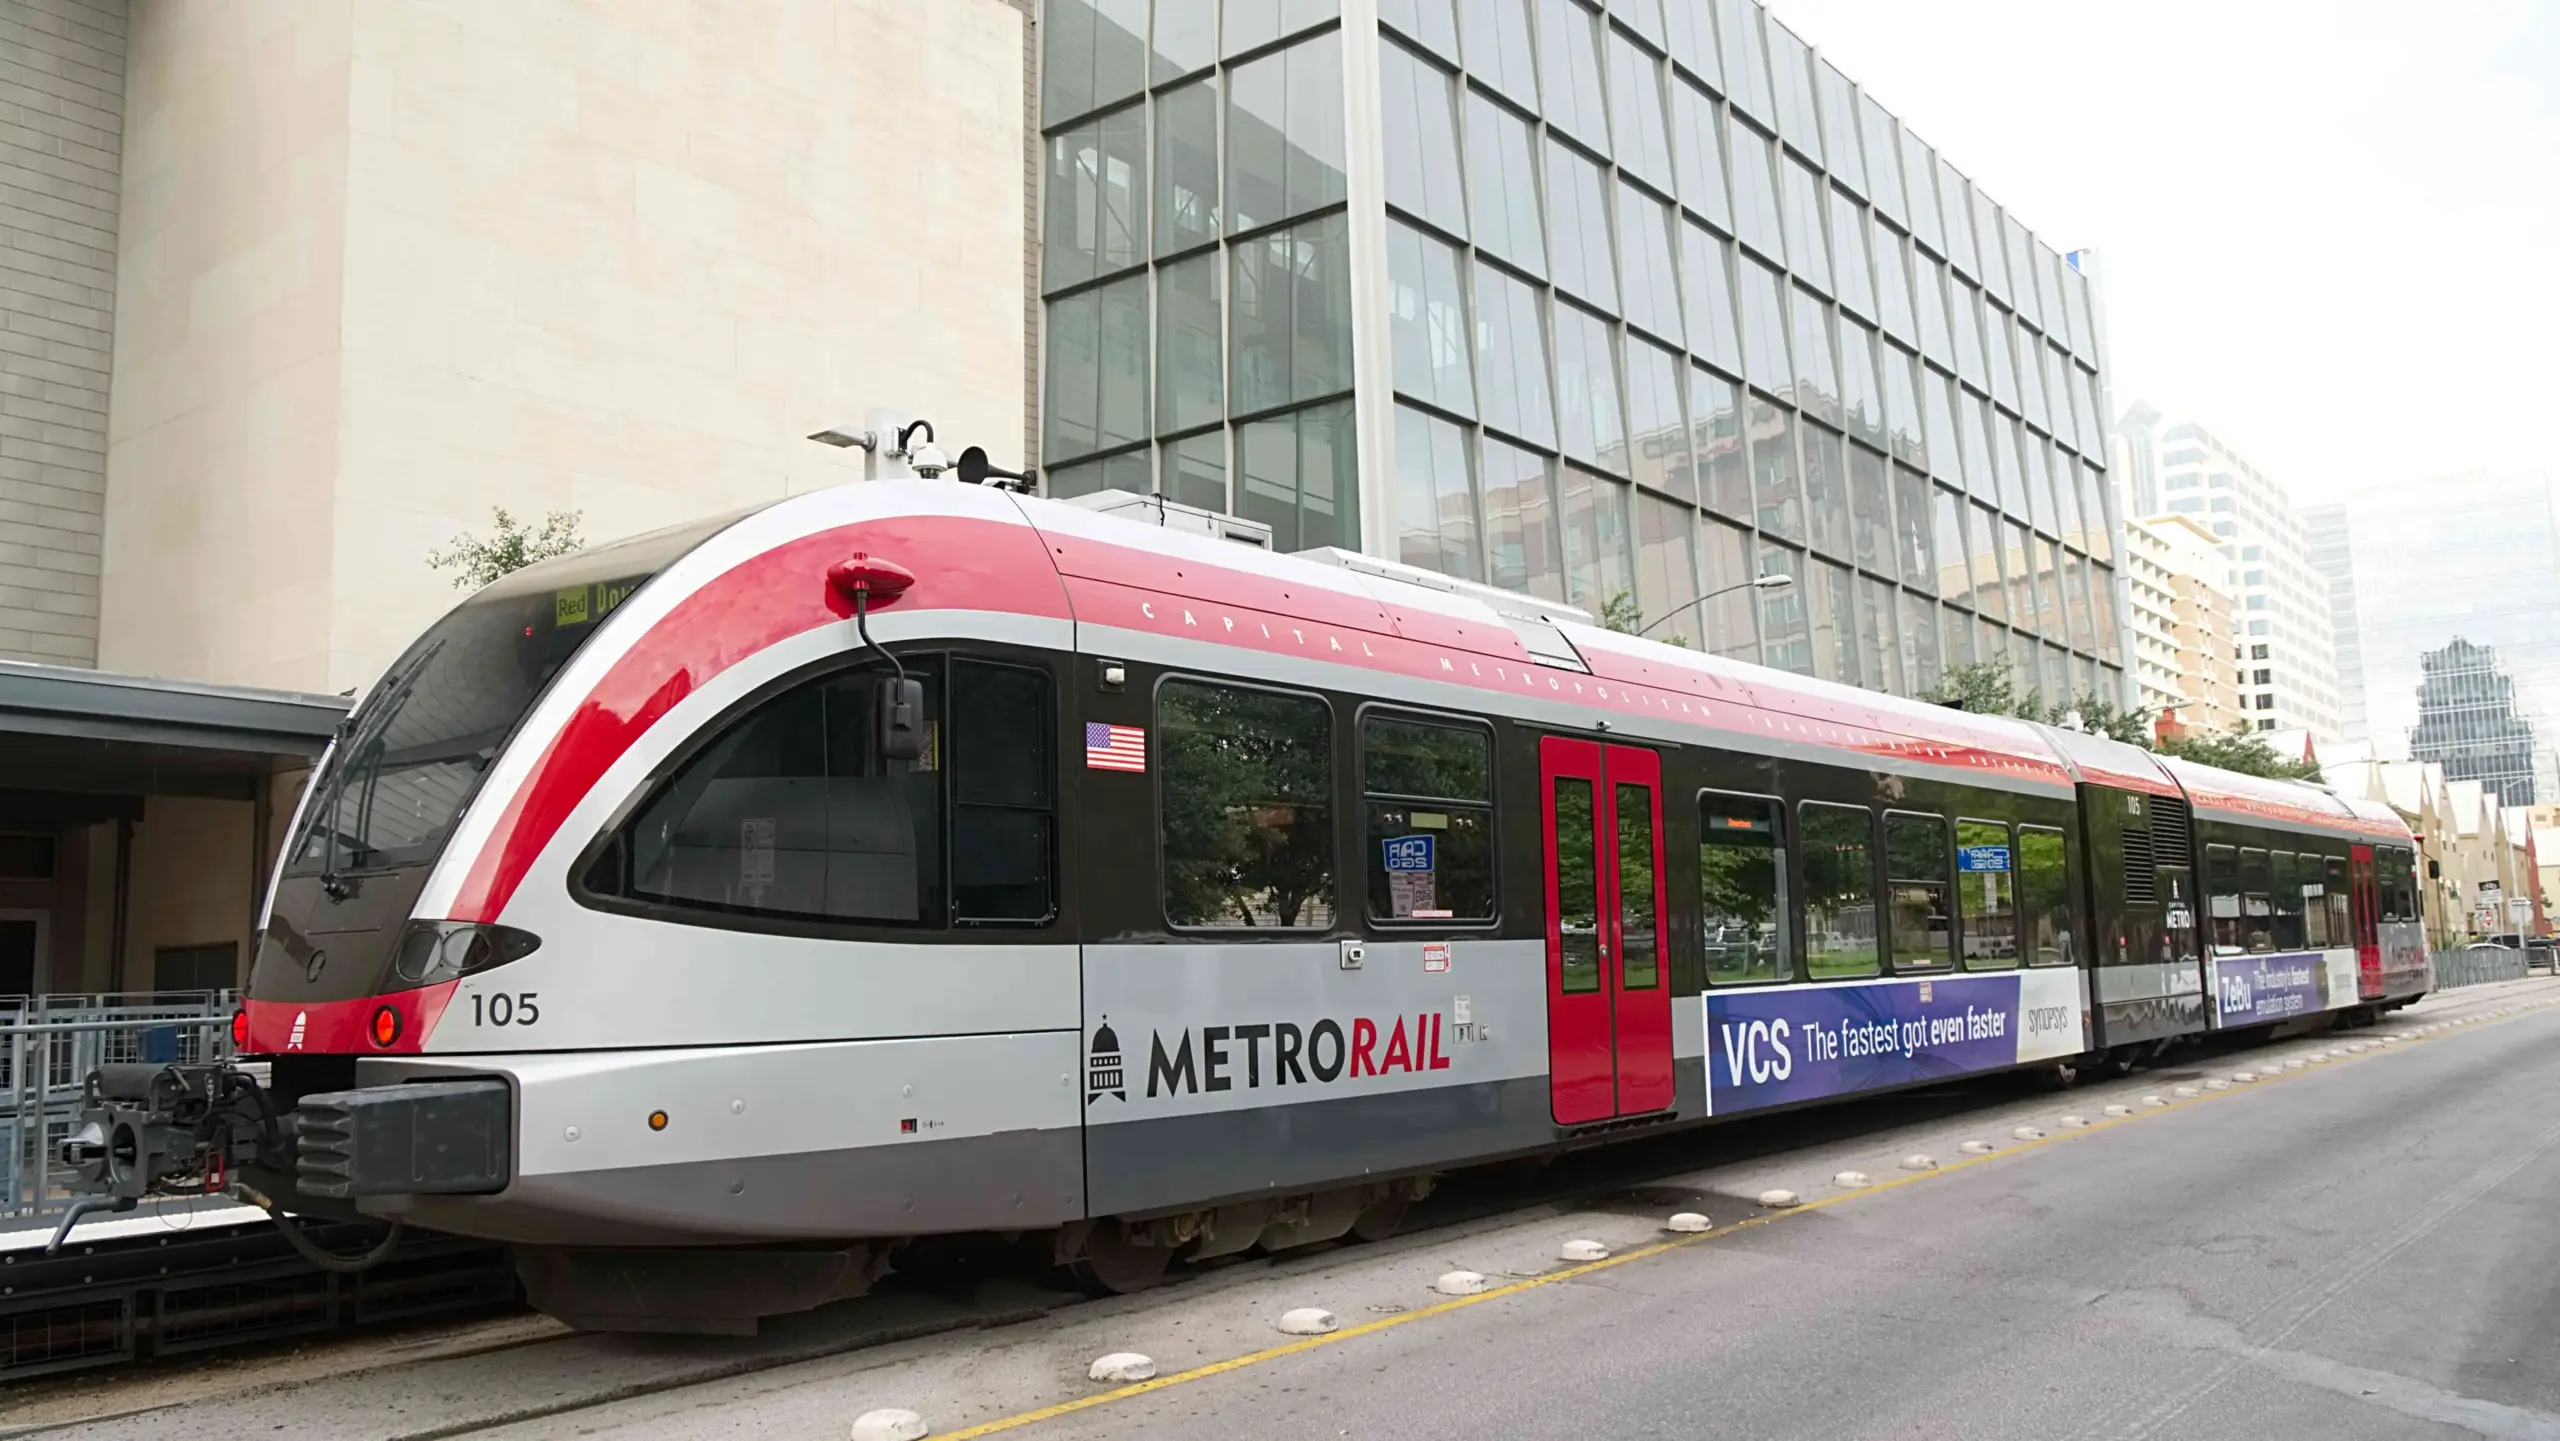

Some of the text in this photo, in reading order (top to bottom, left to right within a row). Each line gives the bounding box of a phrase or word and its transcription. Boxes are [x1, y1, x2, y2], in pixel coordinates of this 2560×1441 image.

[558, 596, 586, 618] Red
[1141, 602, 1374, 657] CAPITAL
[1440, 656, 1712, 718] METROPOLITAN
[2127, 795, 2141, 816] 105
[2166, 910, 2191, 929] METRO
[471, 992, 540, 1026] 105
[2222, 976, 2252, 1013] ZeBu
[1803, 1005, 2007, 1062] The fastest got even faster
[2028, 1005, 2069, 1037] SYNOPSYS
[1146, 1013, 1451, 1098] METRORAIL
[1722, 1017, 1792, 1087] VCS
